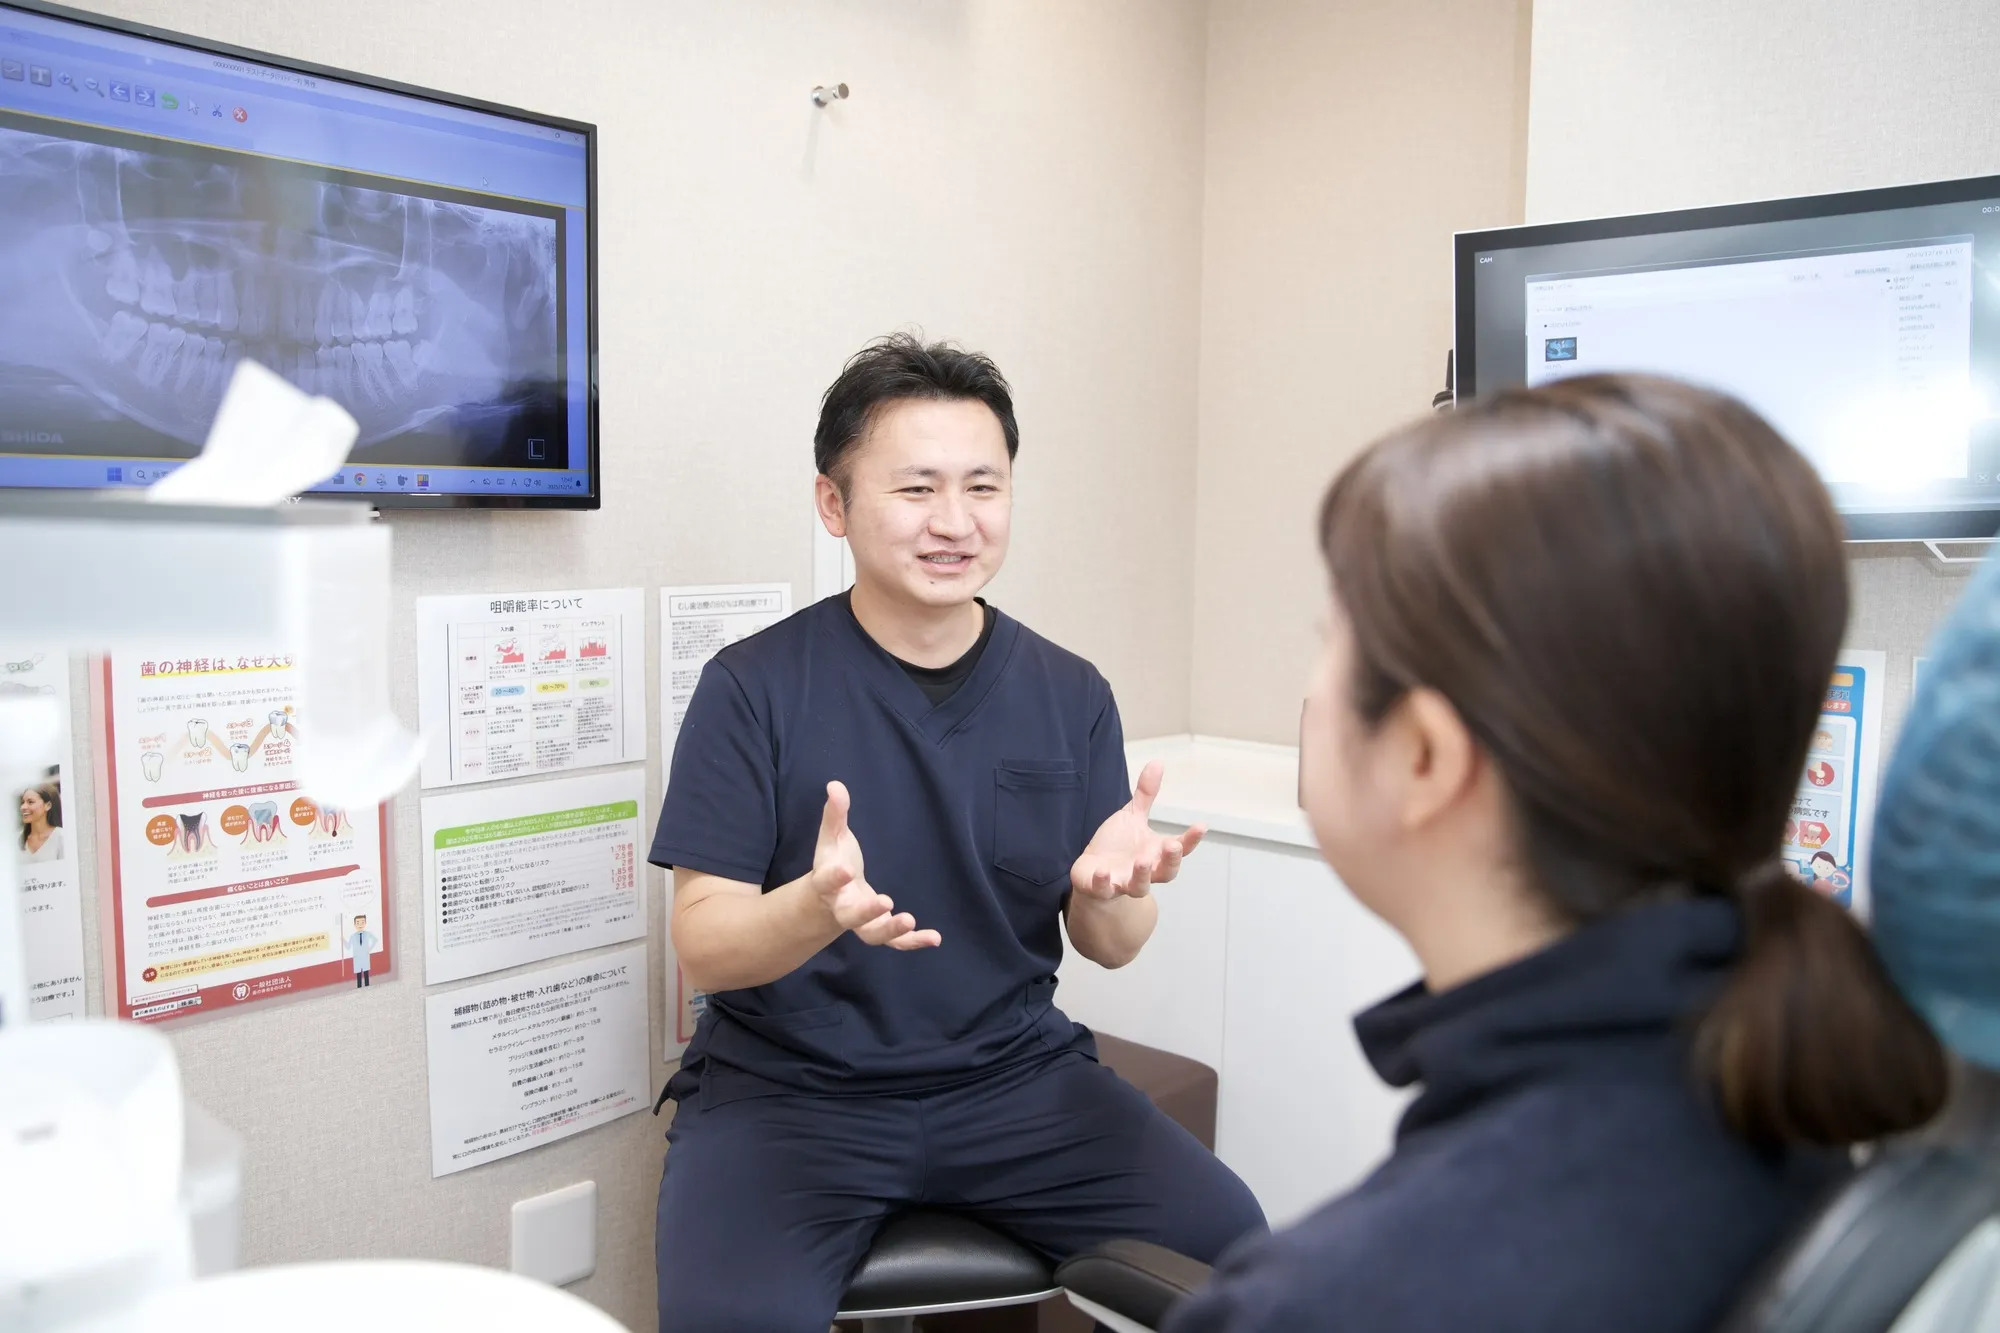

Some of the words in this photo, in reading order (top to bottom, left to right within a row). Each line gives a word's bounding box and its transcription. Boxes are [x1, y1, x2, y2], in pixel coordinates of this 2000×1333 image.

[531, 441, 542, 457] L
[490, 597, 584, 614] 咀嚼能率について
[447, 858, 549, 882] 奥歯がないとうつ・閉じこもりになるリスク
[447, 875, 505, 890] 奥歯がないと転倒リスク
[447, 881, 515, 899] 奥歯がないと認知症のリスク
[448, 912, 475, 924] 死亡リスク
[252, 975, 291, 989] 一般社団法人
[453, 965, 627, 1017] 補綴物(詰め物・被せ物・入れ歯など)の寿命について
